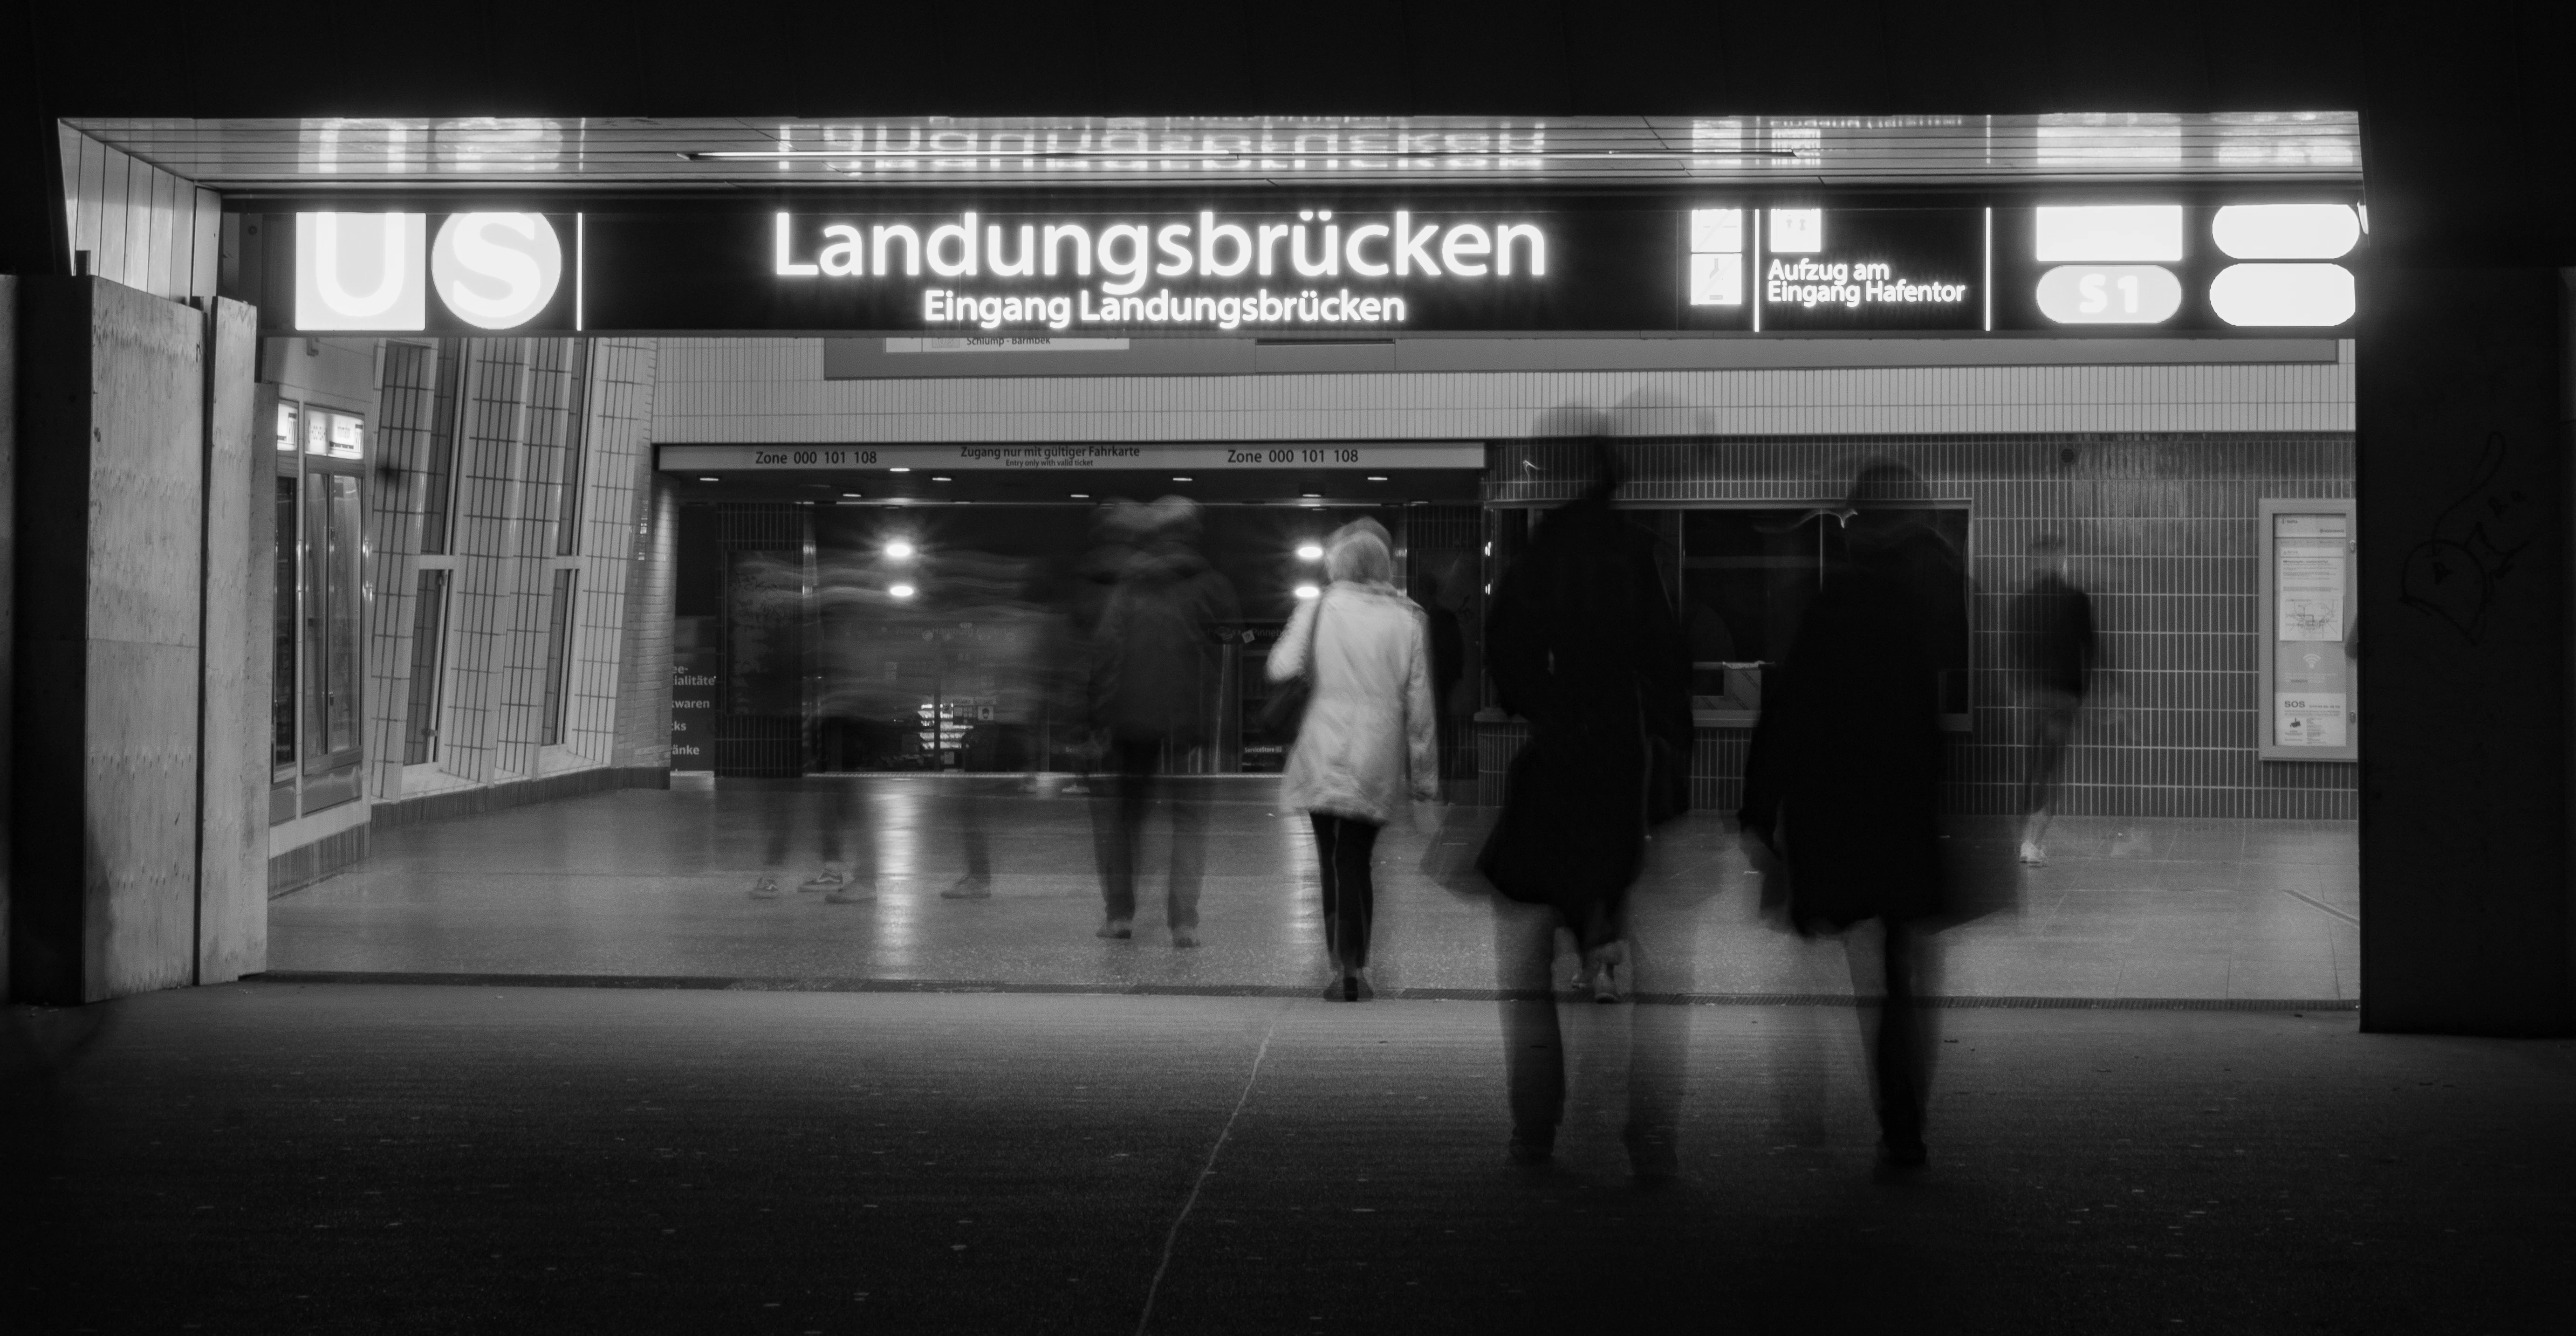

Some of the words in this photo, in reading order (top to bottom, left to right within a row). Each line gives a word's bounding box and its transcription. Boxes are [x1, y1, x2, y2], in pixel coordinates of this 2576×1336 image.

[316, 212, 405, 317] U
[453, 212, 541, 317] S
[775, 211, 1545, 295] Landungsbrücken
[1769, 258, 1849, 285] Aufzug
[1853, 261, 1890, 281] am
[1768, 280, 1860, 307] Eingang
[1866, 280, 1966, 302] Hafentor
[925, 289, 1071, 329] Eingang
[1080, 289, 1405, 329] Landungsbrücken
[755, 451, 788, 464] Zone
[793, 451, 817, 464] 000
[824, 451, 847, 464] 101
[854, 451, 877, 464] 108
[960, 446, 1000, 459] Zugang
[1004, 448, 1021, 457] nur
[1025, 446, 1041, 457] mit
[1044, 446, 1087, 459] gültiger
[1089, 446, 1140, 457] Fahrkarte
[1227, 449, 1262, 464] Zone
[1268, 449, 1295, 463] 000
[1302, 449, 1325, 463] 101
[1334, 449, 1358, 463] 108
[671, 744, 700, 755] änke
